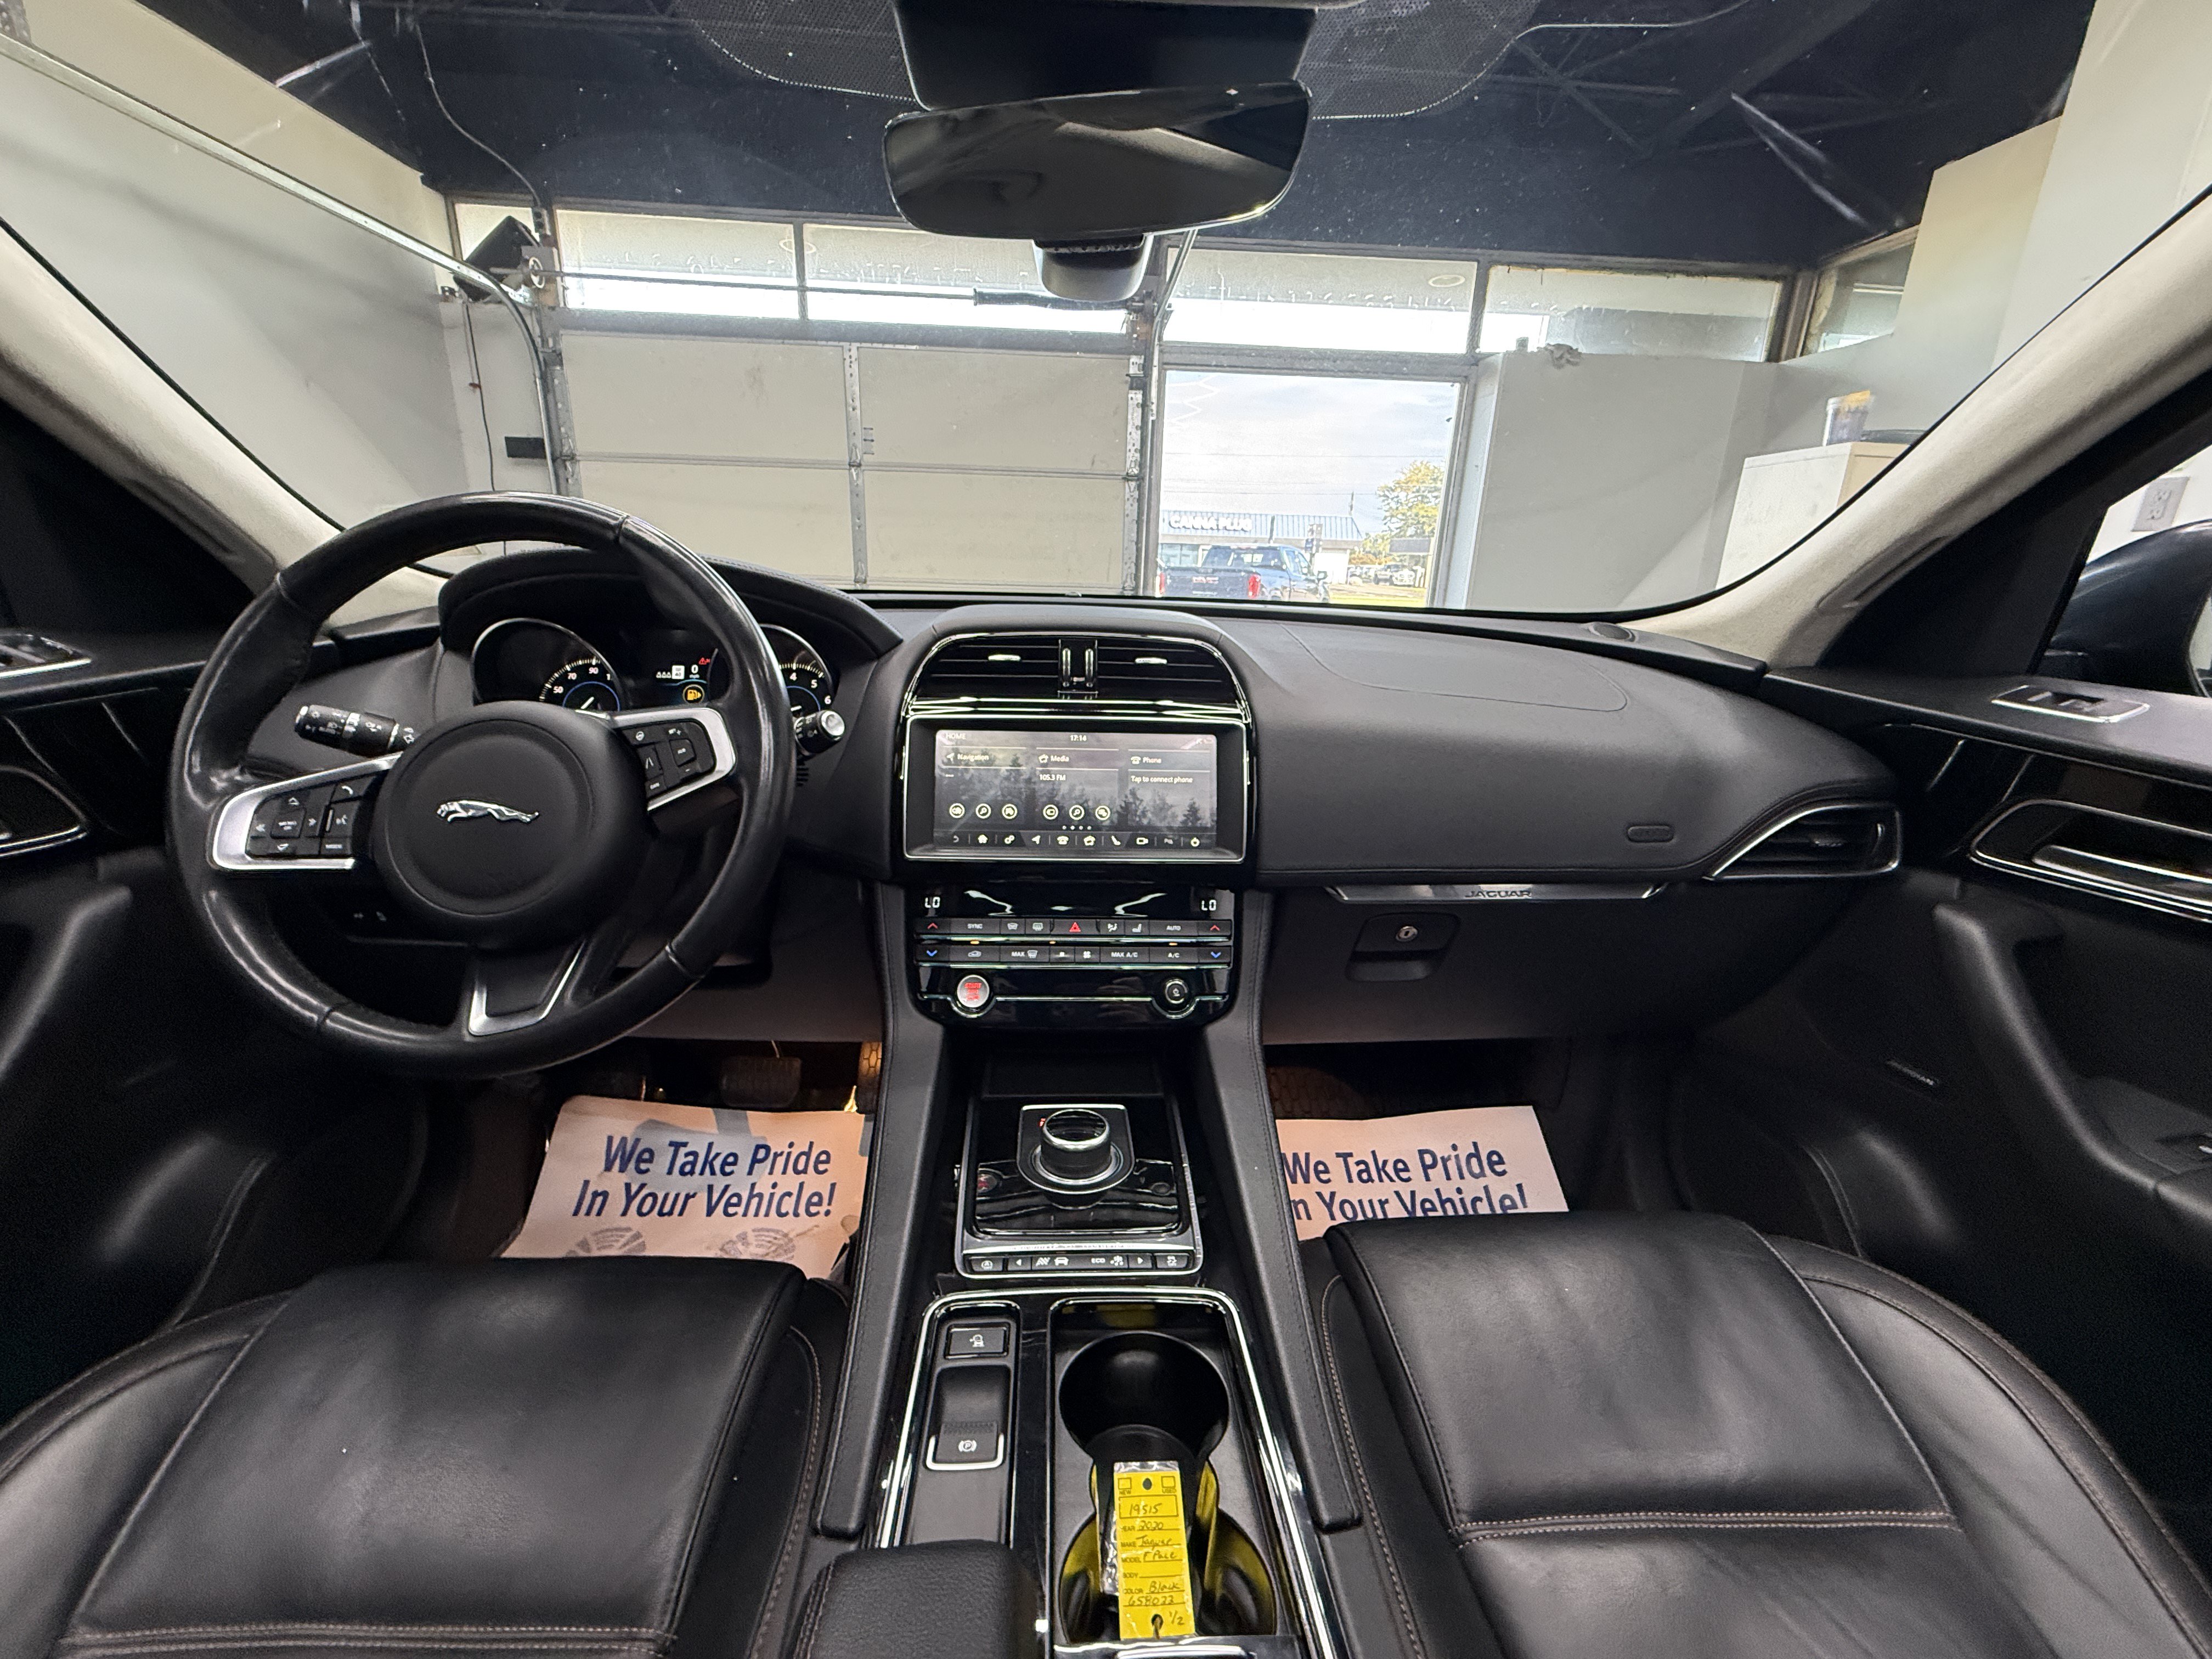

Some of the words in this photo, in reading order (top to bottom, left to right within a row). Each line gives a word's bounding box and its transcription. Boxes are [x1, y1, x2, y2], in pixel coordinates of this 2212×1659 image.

[1169, 515, 1217, 531] CANNA
[691, 664, 699, 674] 0
[789, 672, 797, 681] 4
[811, 679, 817, 689] 5
[825, 695, 831, 704] 6
[957, 754, 989, 762] Navigation
[1131, 775, 1141, 783] Tap
[1465, 890, 1532, 898] JAGUAR
[604, 1135, 656, 1174] We
[665, 1140, 739, 1177] Take
[747, 1141, 832, 1176] Pride
[1282, 1152, 1330, 1184] We
[1335, 1150, 1412, 1184] Take
[1418, 1141, 1509, 1182] Pride
[572, 1180, 610, 1217] In
[620, 1182, 697, 1218] Your
[705, 1182, 837, 1218] Vehicle!
[1292, 1198, 1312, 1221] n
[1315, 1191, 1390, 1222] Your
[1130, 1503, 1163, 1517] 19515
[1138, 1520, 1164, 1531] 2020
[1149, 1581, 1180, 1593] Black
